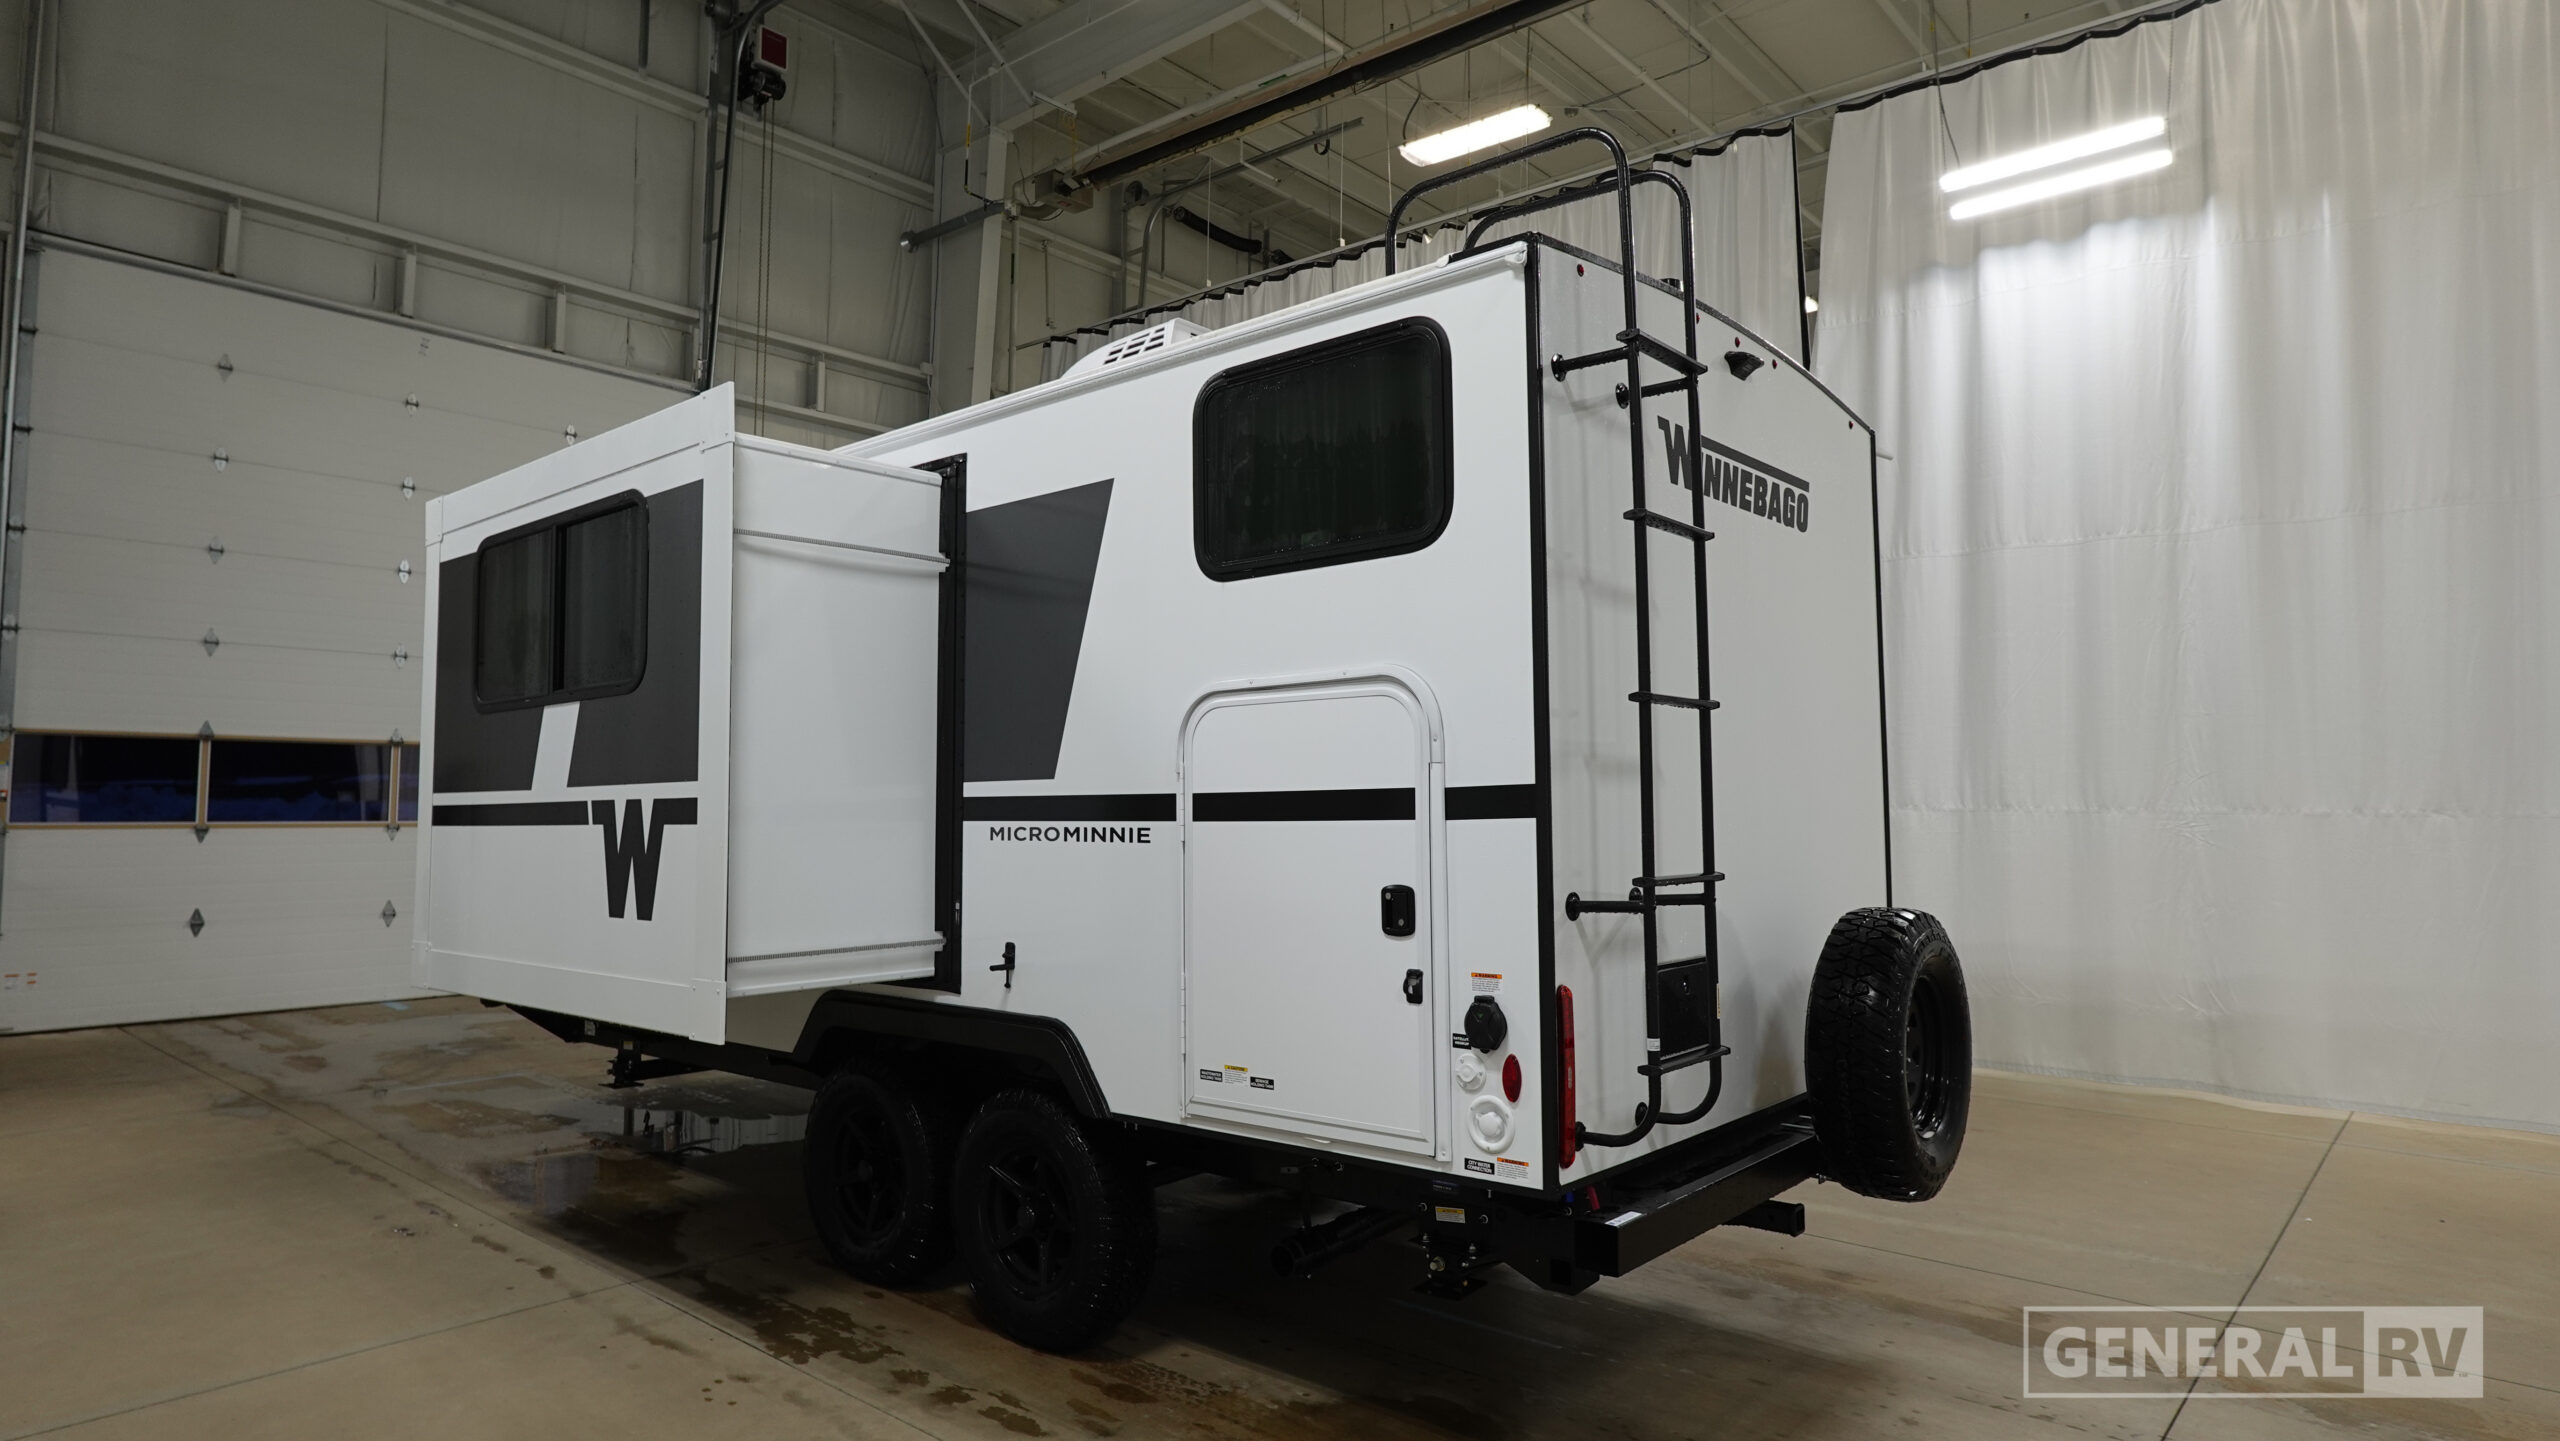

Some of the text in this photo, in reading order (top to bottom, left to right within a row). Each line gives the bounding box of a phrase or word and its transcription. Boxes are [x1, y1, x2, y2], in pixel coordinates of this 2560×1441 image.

[1657, 415, 1809, 533] WNNEBAGO
[990, 826, 1151, 844] MICROMINNIE
[591, 797, 698, 921] W
[1466, 1164, 1493, 1174] CONNECTION
[1477, 1161, 1491, 1169] WATER
